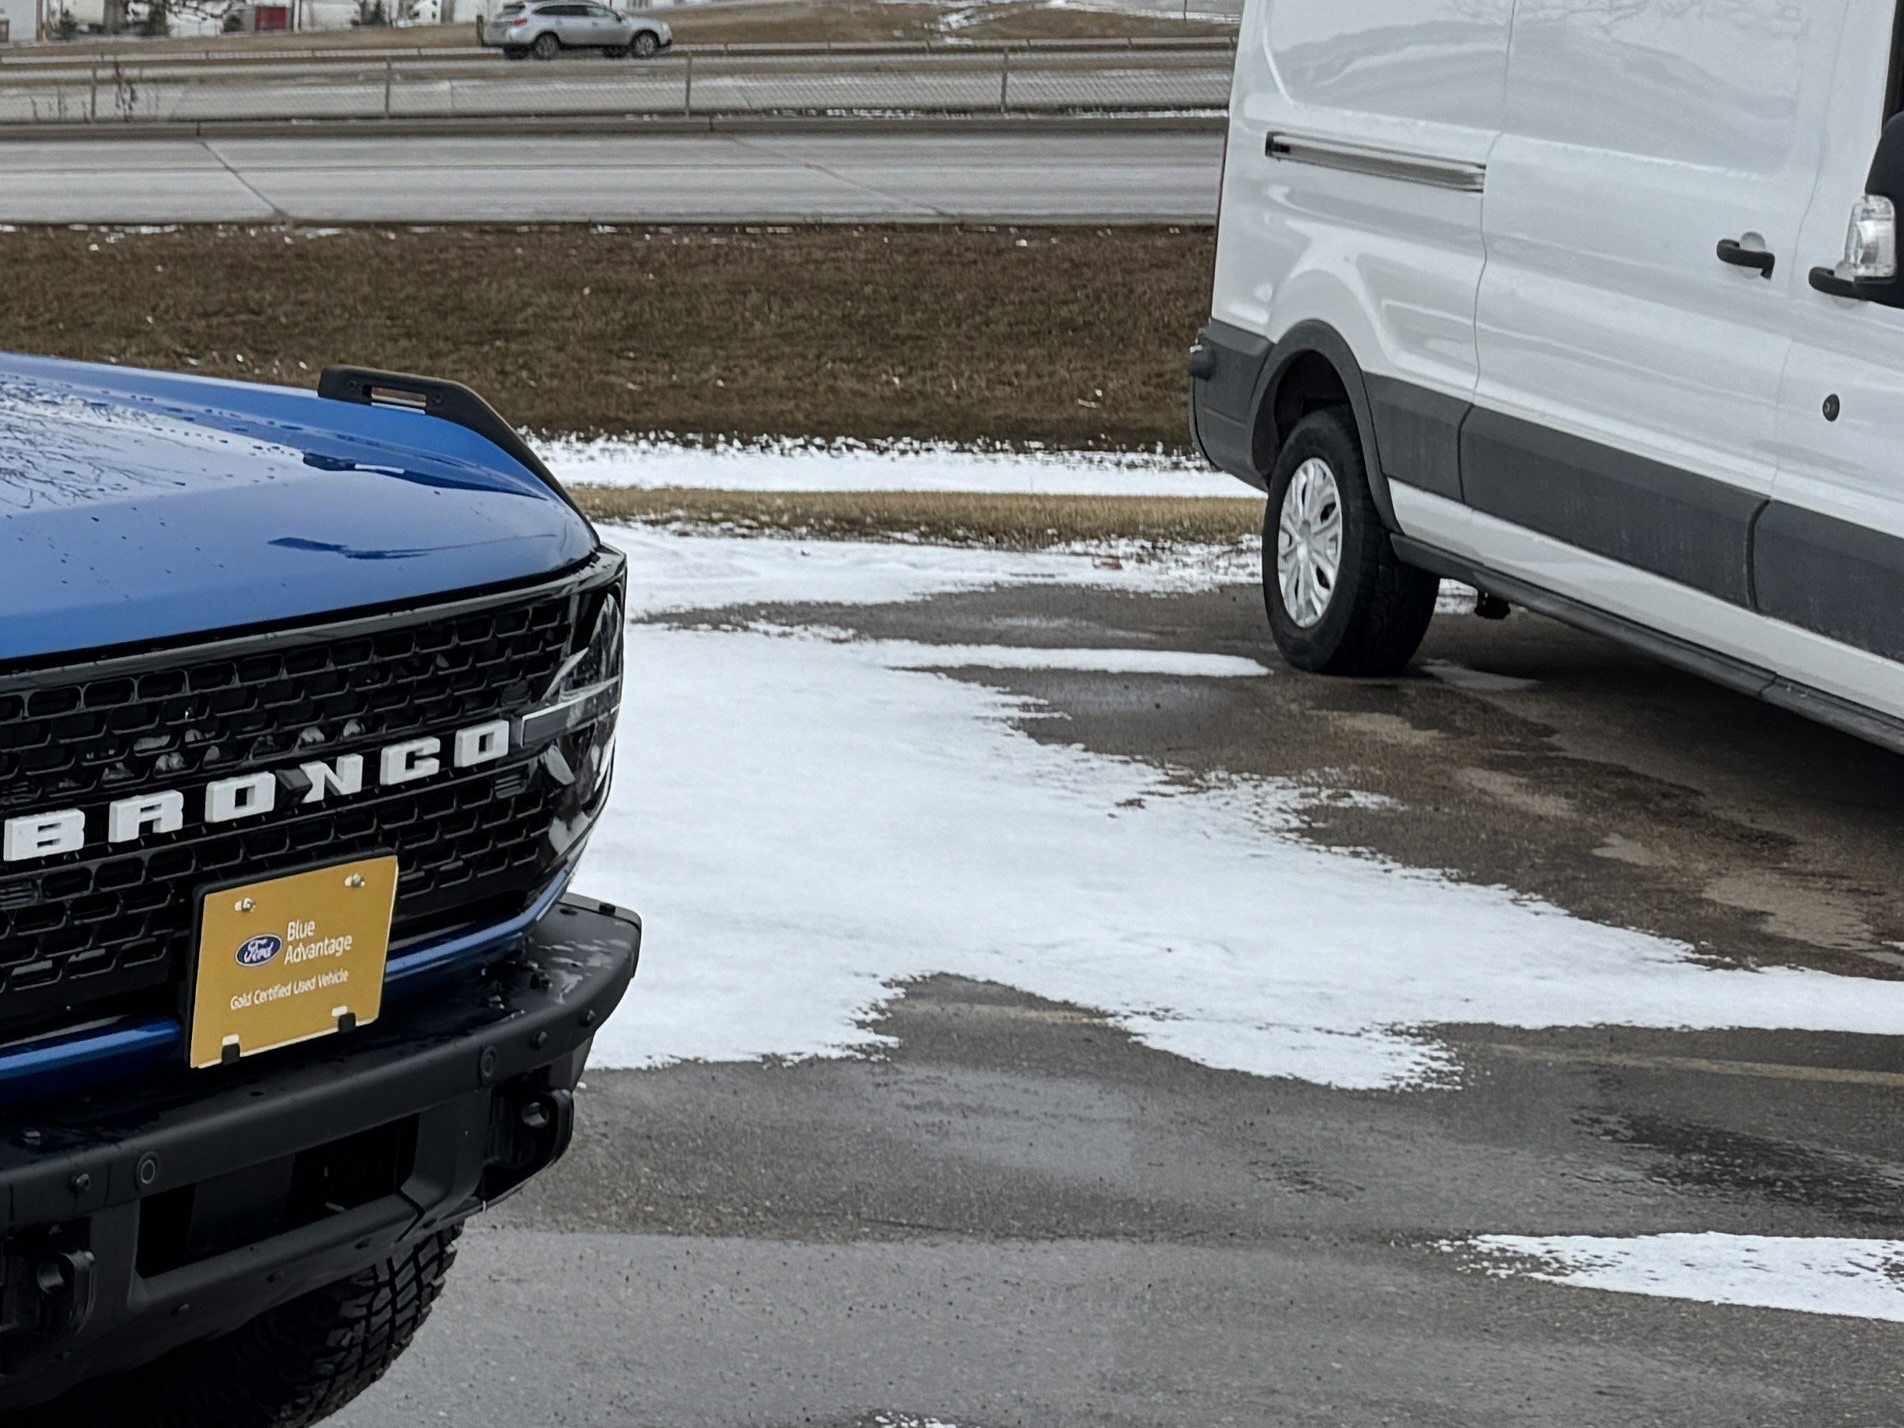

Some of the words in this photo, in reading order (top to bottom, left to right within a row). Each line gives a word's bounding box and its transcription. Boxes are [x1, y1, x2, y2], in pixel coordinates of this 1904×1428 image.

[3, 719, 510, 863] BRONCO
[287, 919, 316, 941] Blue
[242, 937, 277, 964] Ford
[284, 934, 353, 966] Advantage
[230, 991, 253, 1010] Gold
[253, 982, 292, 1005] Certified
[293, 978, 317, 995] Used
[318, 968, 349, 987] Vehicle
